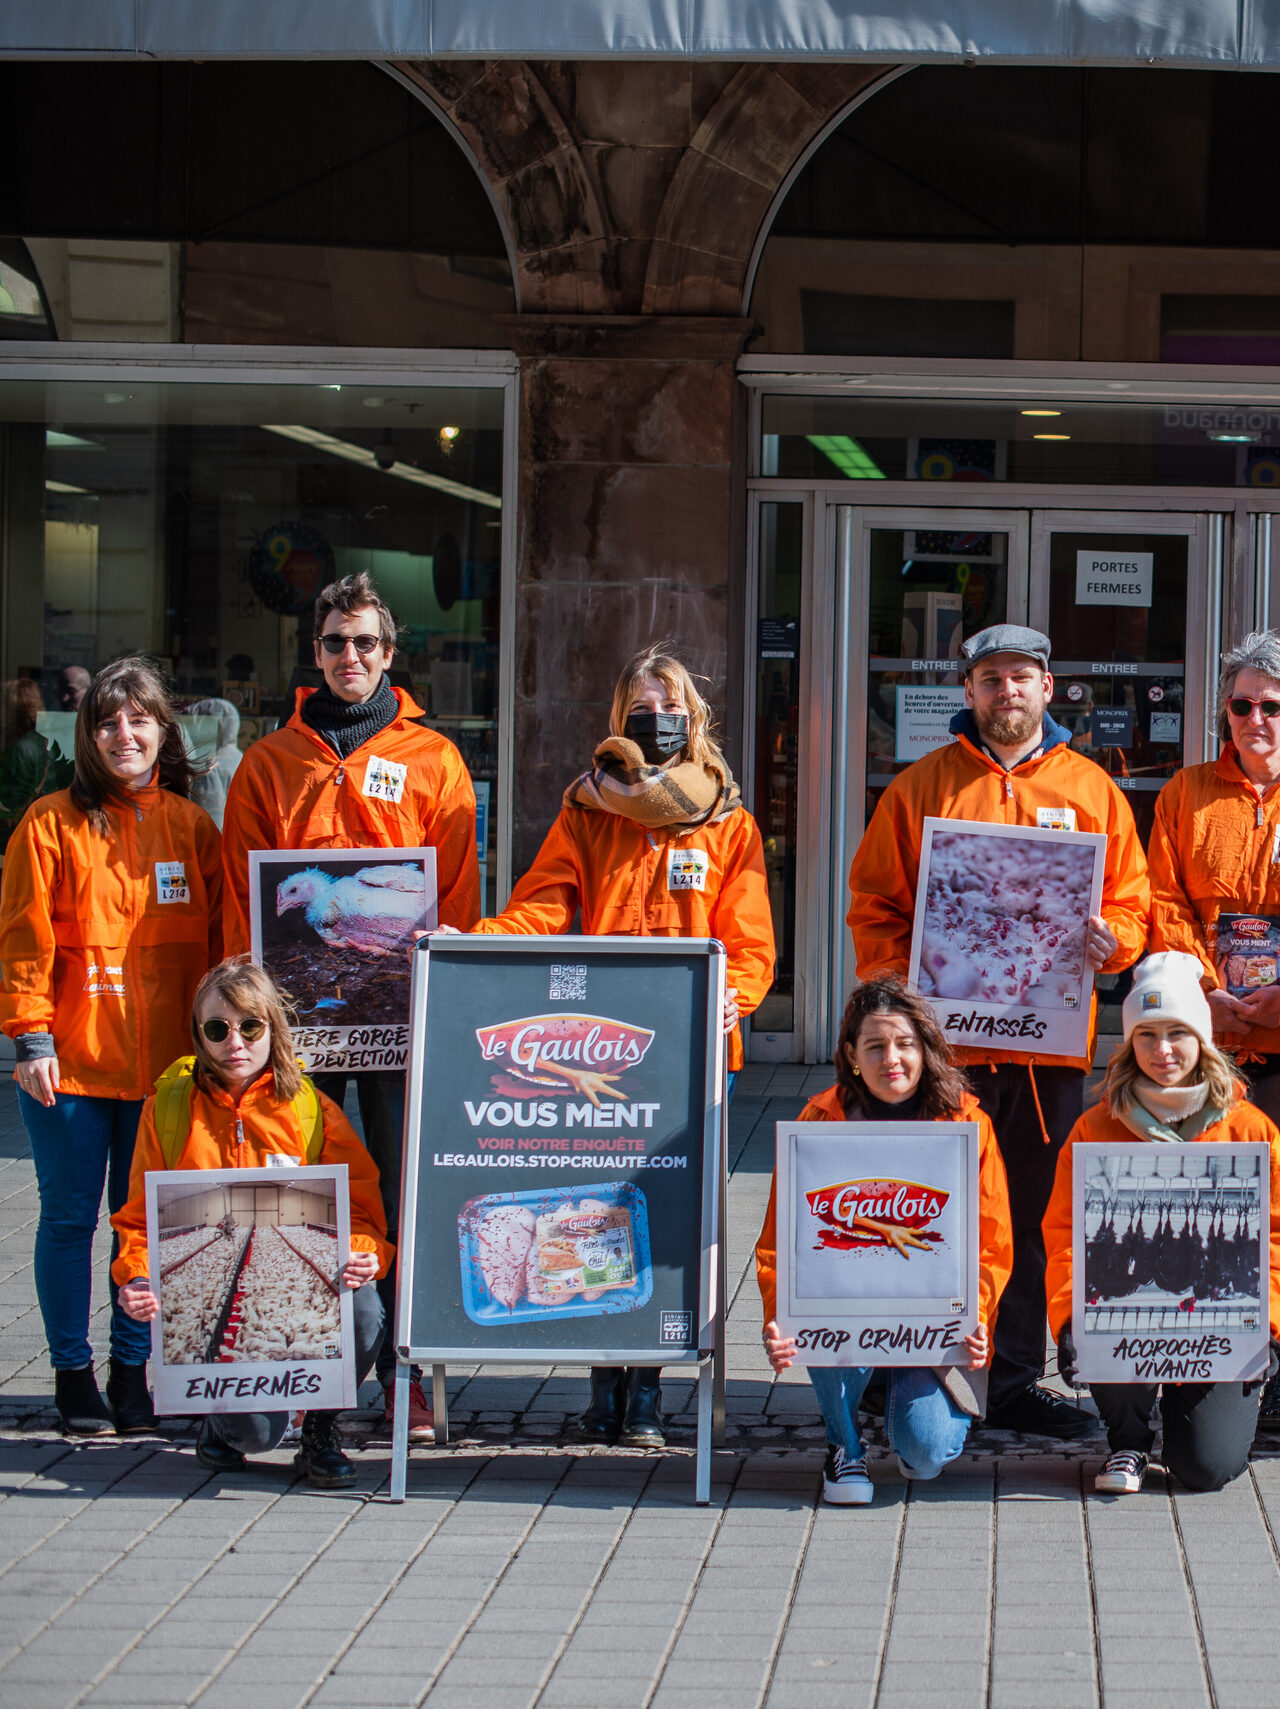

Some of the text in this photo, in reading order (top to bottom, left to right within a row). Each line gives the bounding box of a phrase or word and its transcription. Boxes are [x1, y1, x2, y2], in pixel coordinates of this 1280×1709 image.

[1092, 561, 1138, 573] PORTES
[1087, 582, 1142, 594] FERMEES
[911, 660, 958, 670] ENTREE
[1091, 663, 1138, 674] ENTREE
[1113, 778, 1137, 788] REE
[673, 874, 701, 885] L214
[162, 888, 186, 899] L214
[1239, 920, 1269, 932] Gaulois
[1230, 938, 1272, 947] VOUS MENT
[944, 1010, 1048, 1039] ENTASSÉS
[348, 1026, 410, 1047] GORGÉ
[486, 1024, 641, 1073] le Gaulois
[310, 1049, 409, 1068] DÉJECTION
[463, 1100, 661, 1128] VOUS MENT
[477, 1136, 646, 1152] VOIR NOTRE ENQUÊTE
[433, 1153, 688, 1169] LEGAULOIS.STOPCRUAUTE.COM
[812, 1186, 940, 1228] le Gaulois
[664, 1332, 688, 1340] L214
[795, 1320, 965, 1354] STOP CRUAUTÉ
[1135, 1358, 1213, 1379] VIVANTS
[185, 1368, 322, 1400] ENFERMÉS
